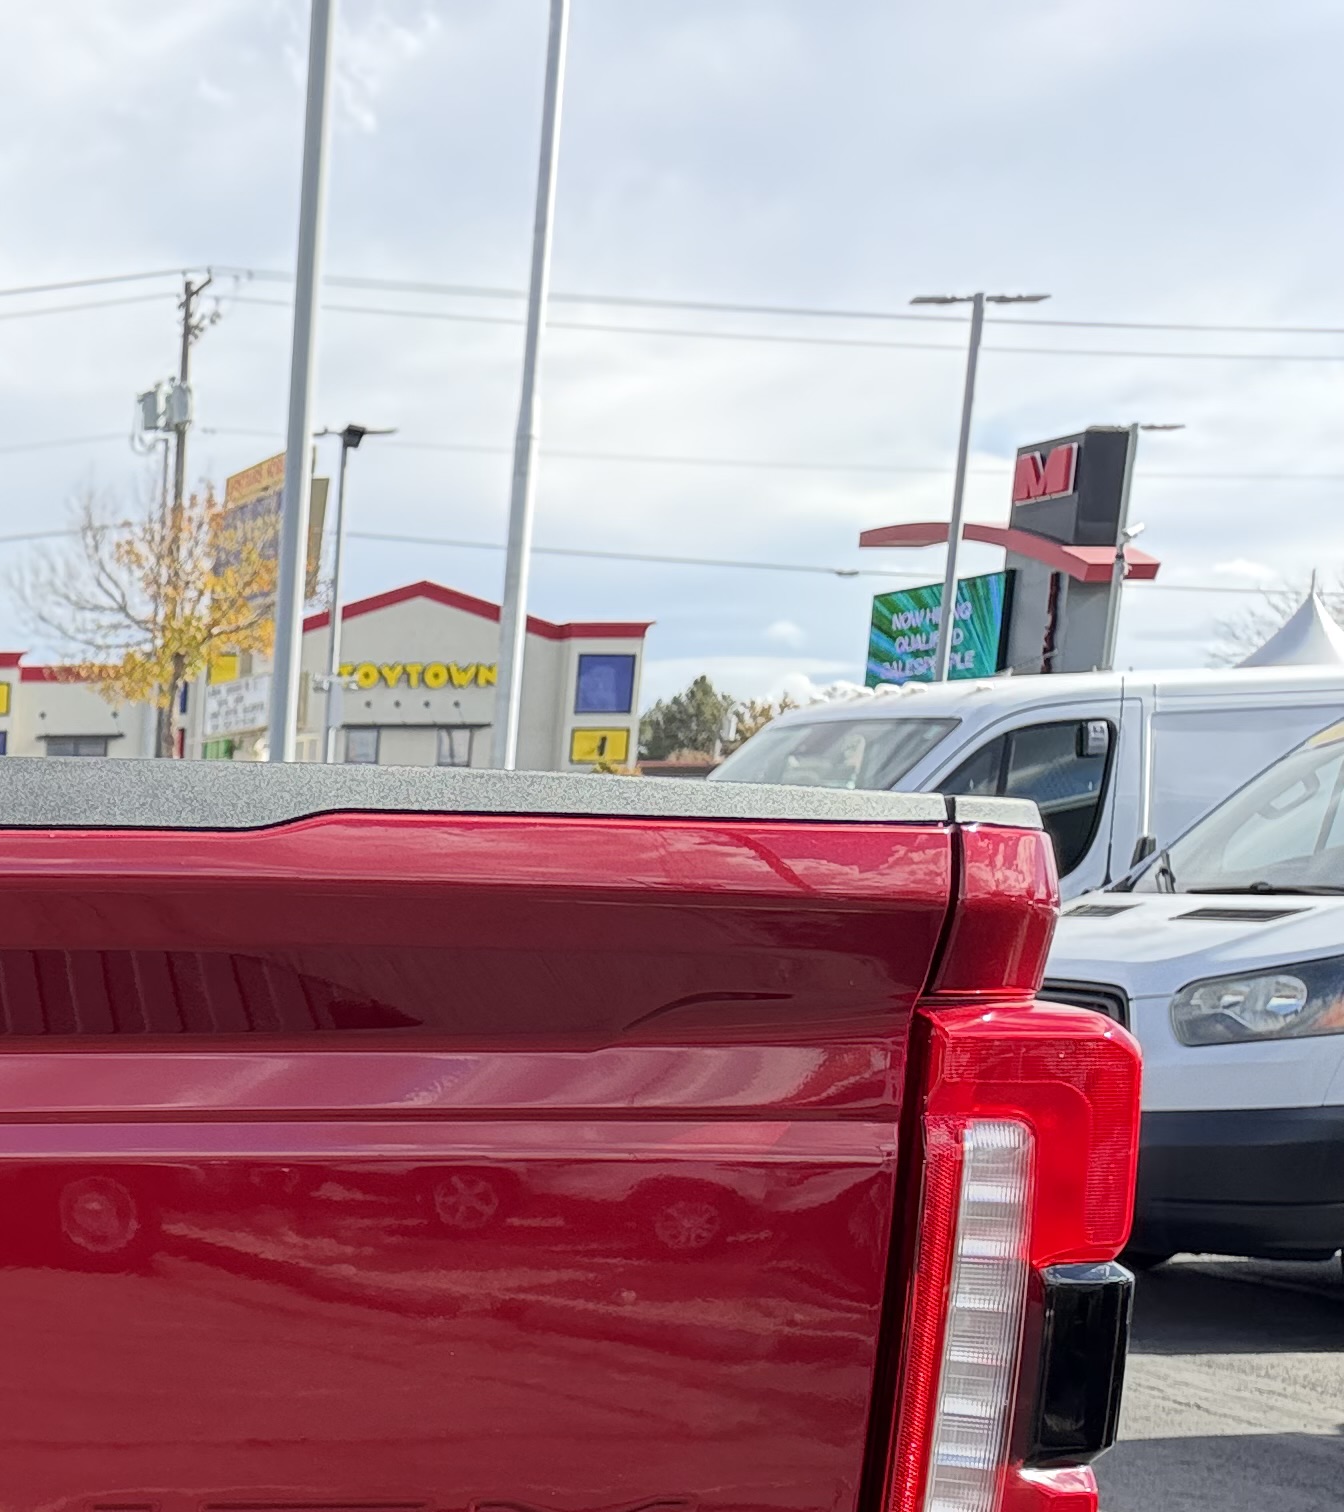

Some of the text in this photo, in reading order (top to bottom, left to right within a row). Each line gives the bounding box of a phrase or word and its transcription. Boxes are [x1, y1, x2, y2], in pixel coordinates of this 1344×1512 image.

[1014, 443, 1078, 505] M
[892, 600, 972, 630] NOW HING
[894, 628, 964, 654] QUALIFD
